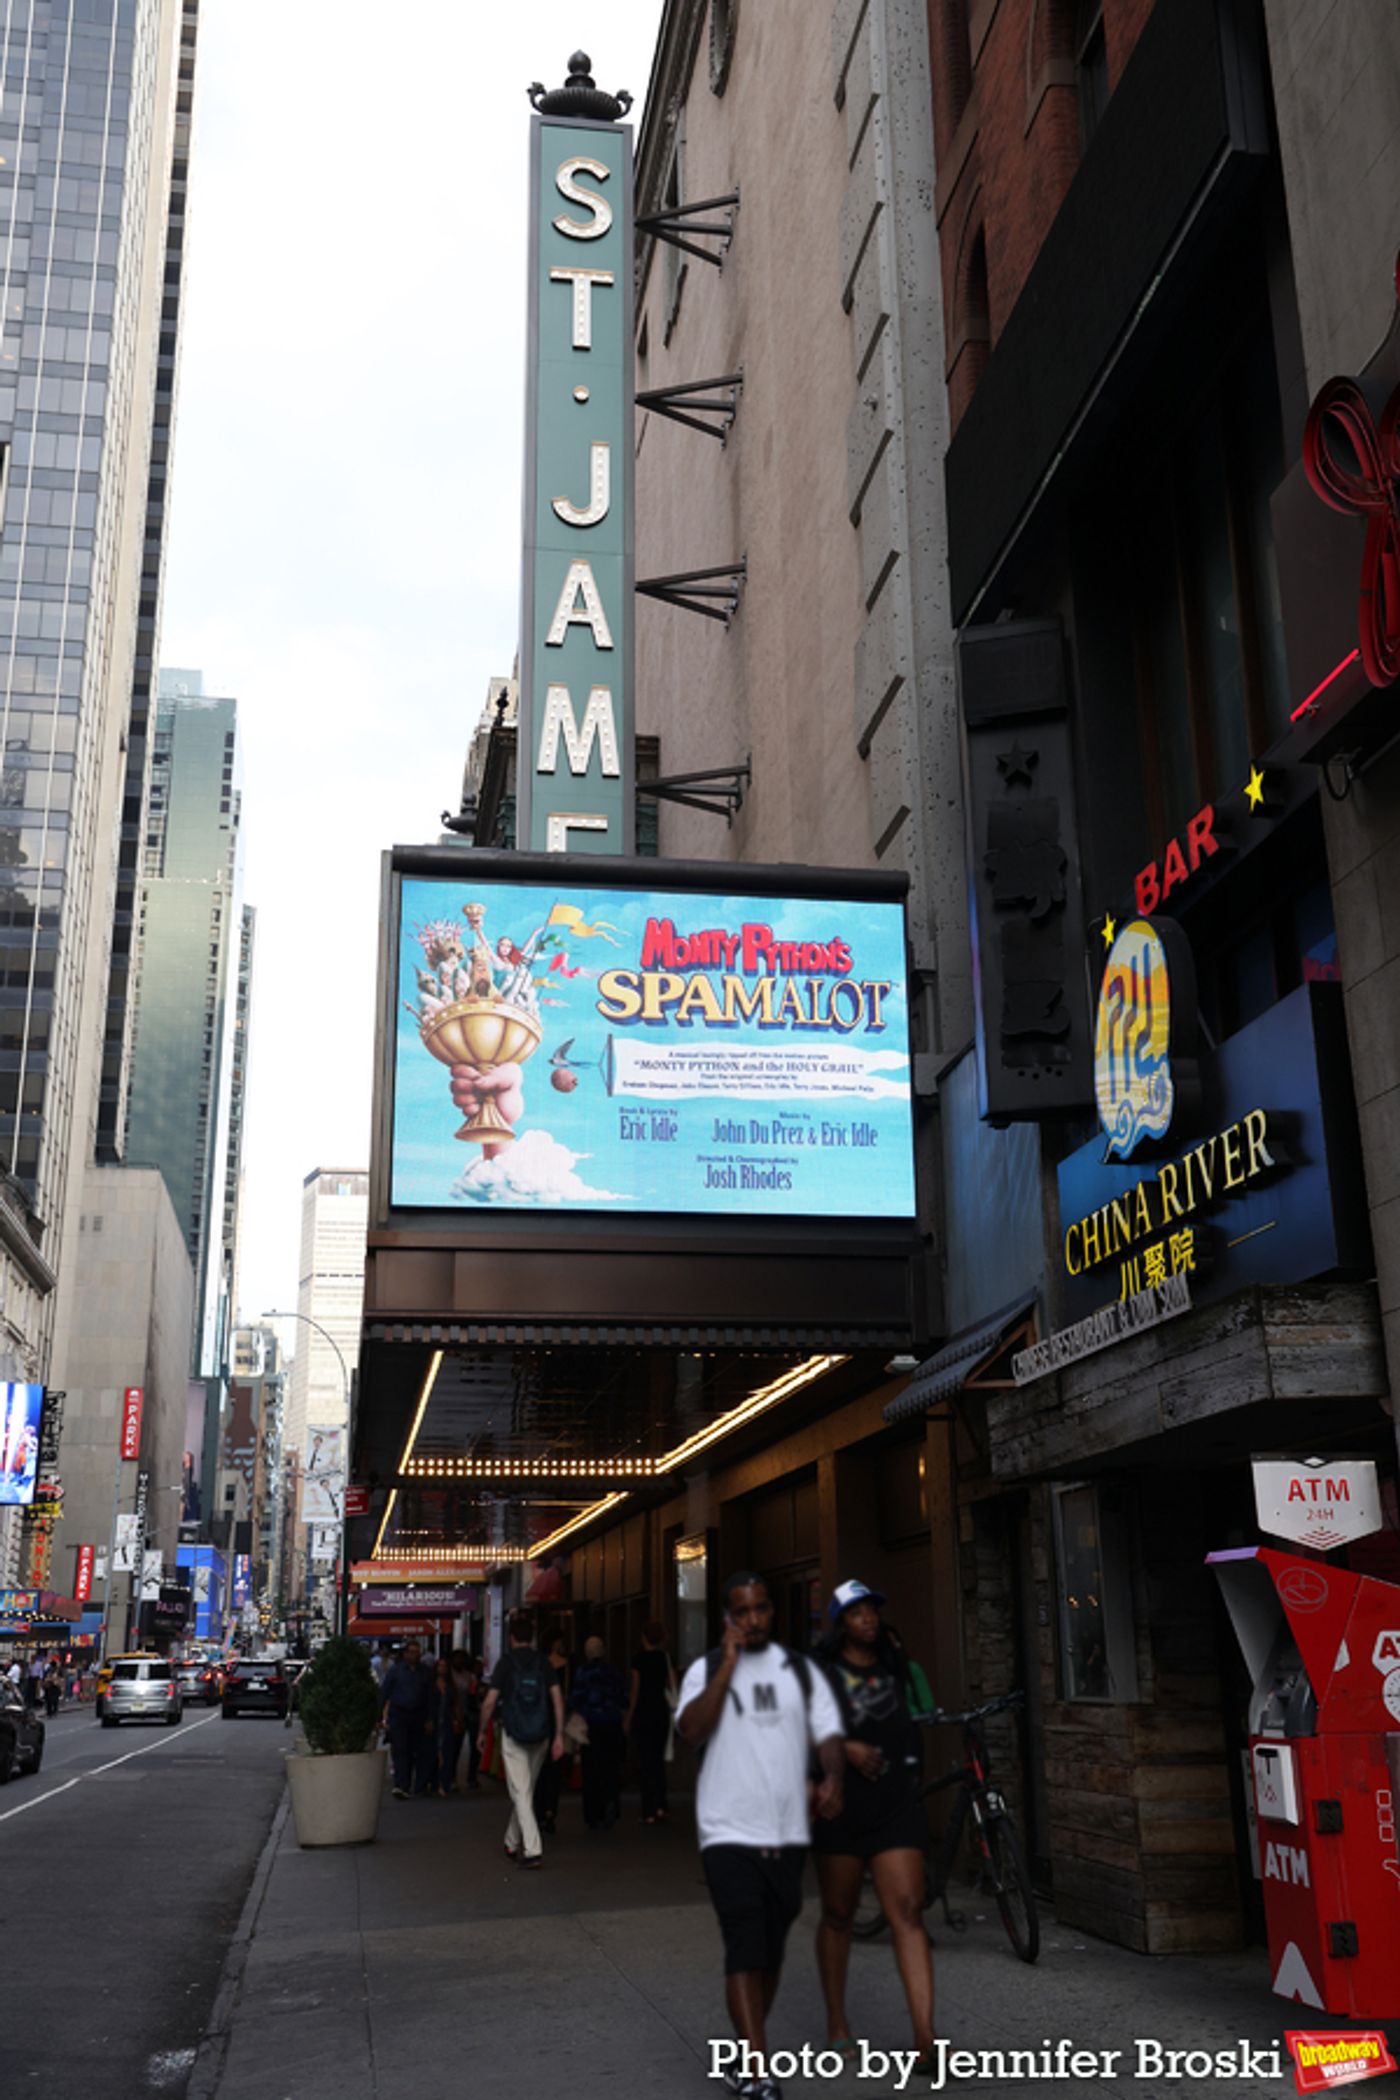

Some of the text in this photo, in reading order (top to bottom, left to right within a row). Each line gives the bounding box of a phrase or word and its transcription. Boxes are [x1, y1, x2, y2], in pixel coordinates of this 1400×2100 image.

[1135, 803, 1220, 917] BAR
[596, 968, 892, 1034] SPAMALOT
[688, 1060, 740, 1072] PYTHON
[742, 1061, 764, 1072] and
[765, 1061, 784, 1072] the
[786, 1062, 820, 1073] HOLY
[620, 1115, 678, 1142] Eric Idle
[711, 1118, 879, 1147] John Du Prez & Eric Idle
[704, 1164, 793, 1190] Josh Rhodes
[1065, 1108, 1276, 1276] CHINA RIVER
[1120, 1227, 1197, 1302] 川聚院
[1288, 1478, 1350, 1502] ATM
[1306, 1508, 1334, 1521] 24H
[1378, 1636, 1400, 1660] A
[752, 1682, 778, 1712] M
[1264, 1841, 1311, 1889] ATM
